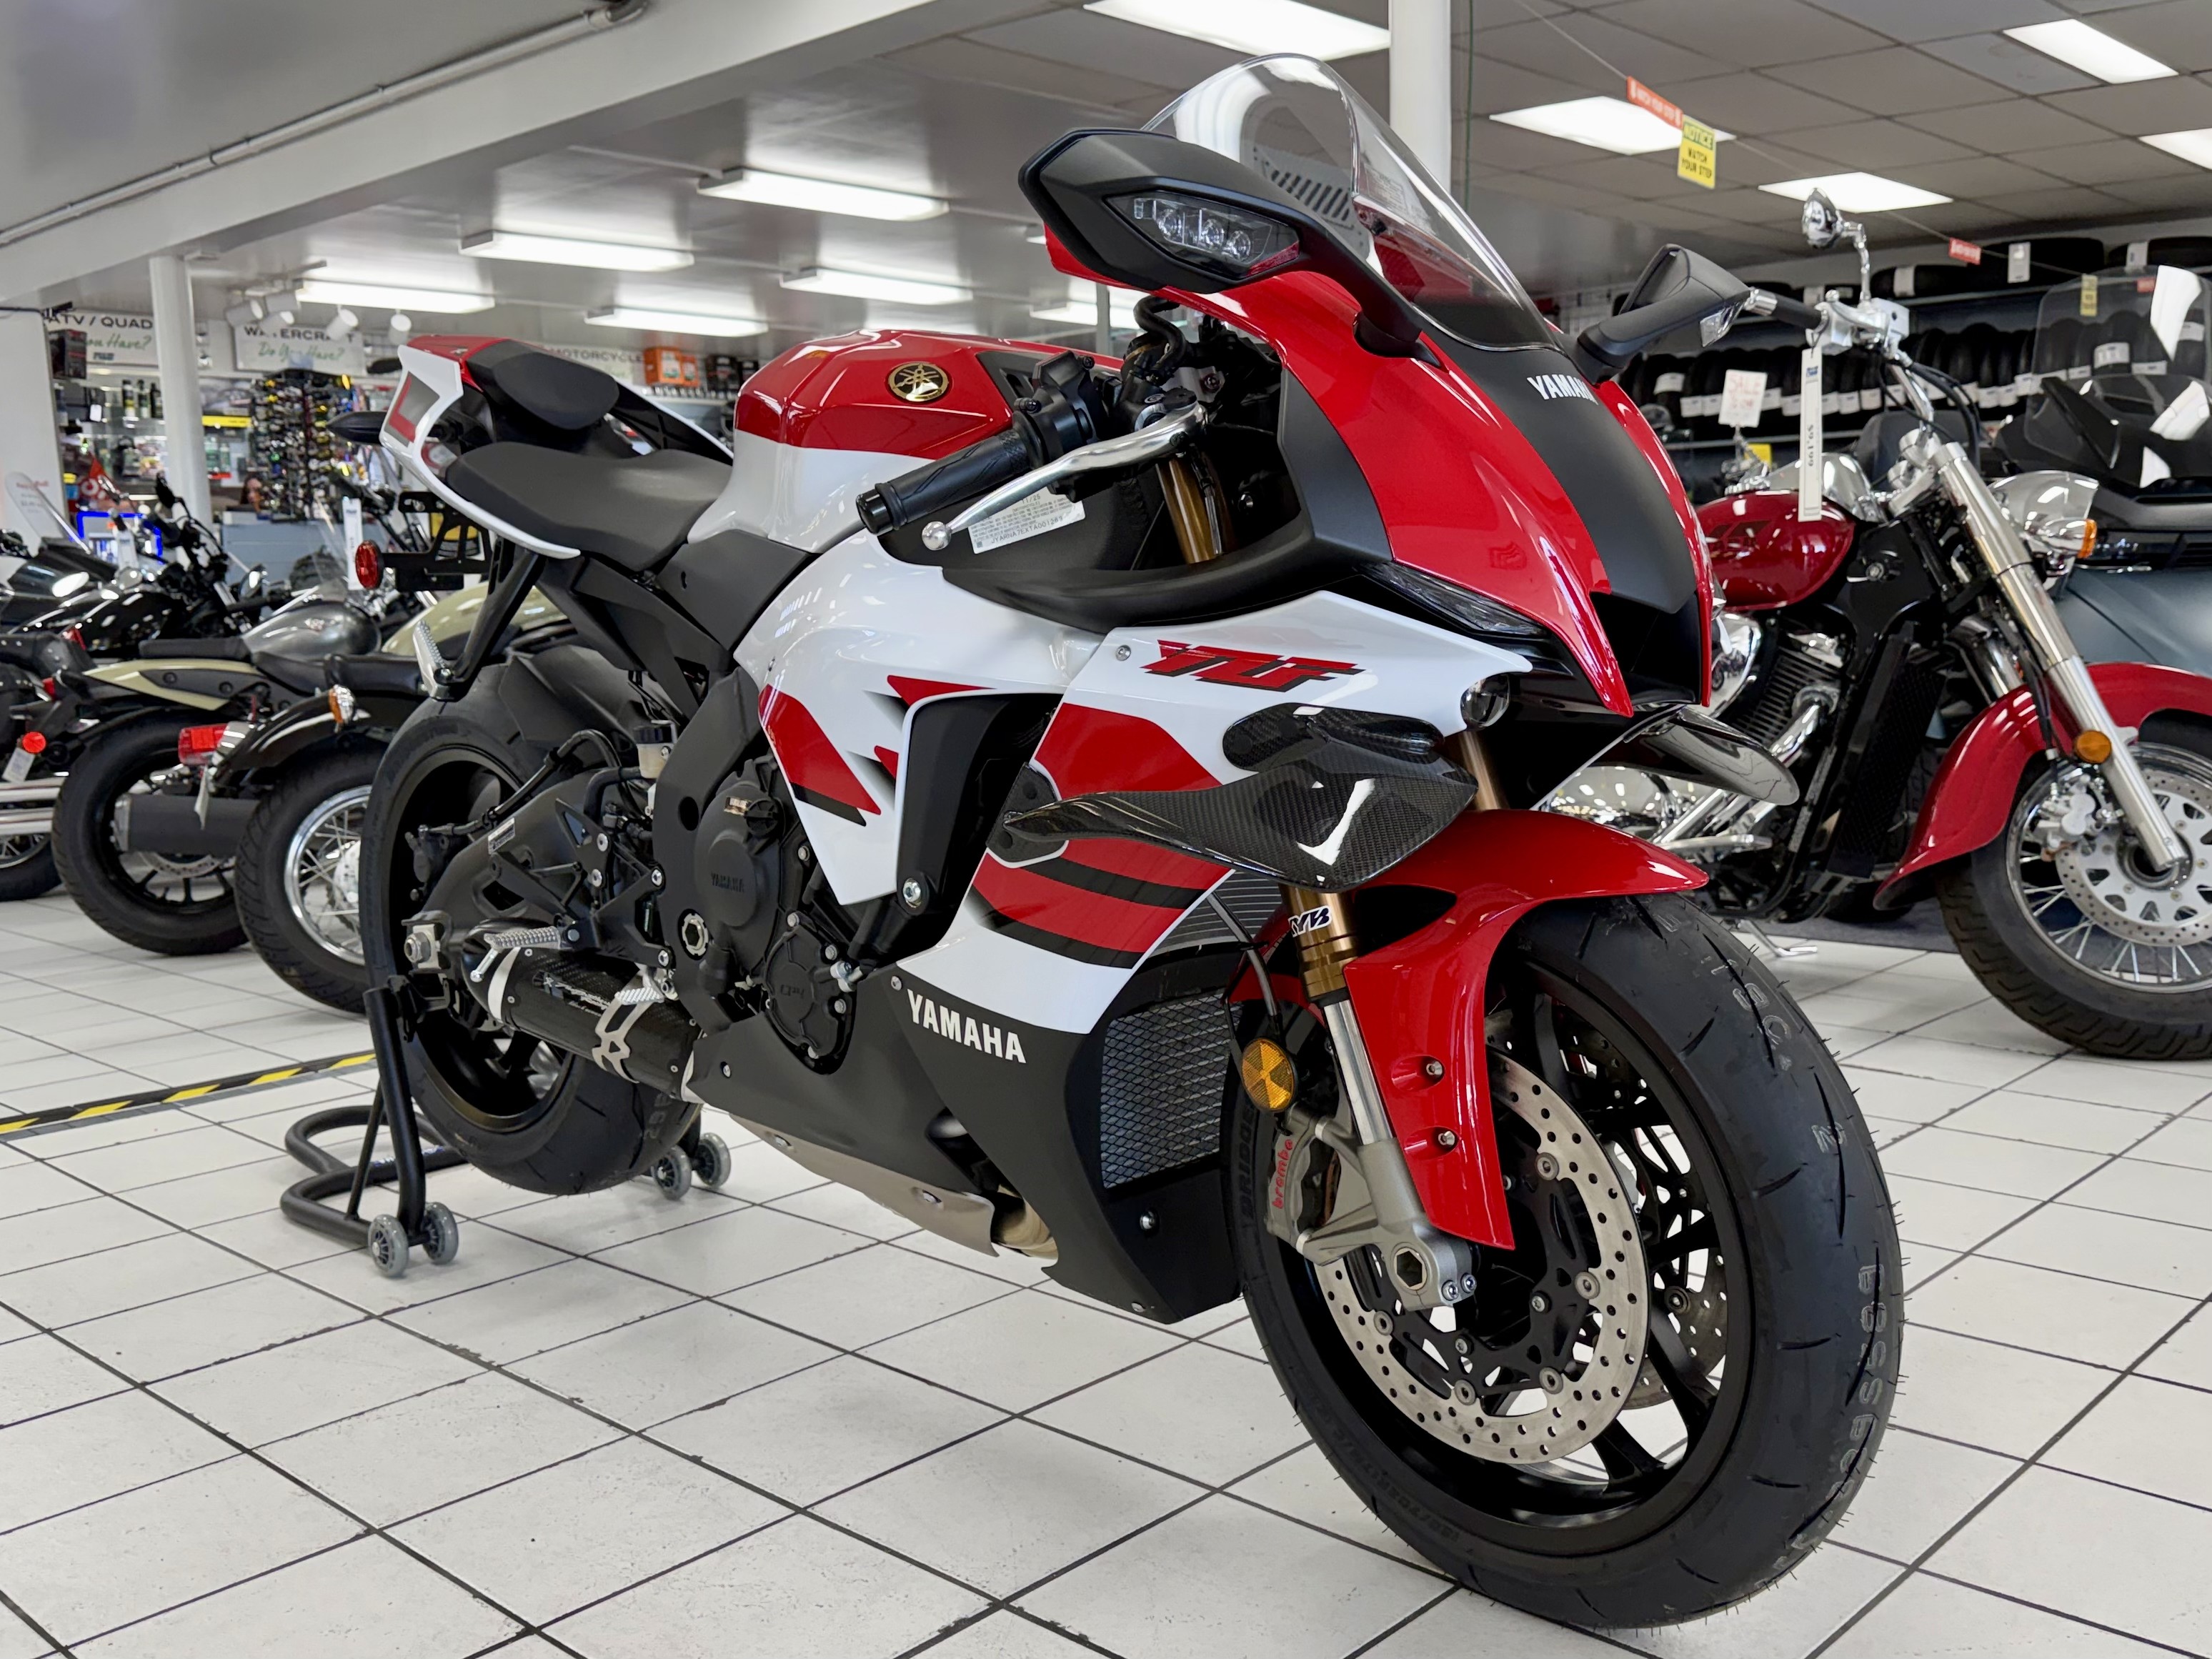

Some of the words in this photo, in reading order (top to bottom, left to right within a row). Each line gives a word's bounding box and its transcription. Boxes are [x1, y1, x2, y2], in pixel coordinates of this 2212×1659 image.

[1683, 121, 1713, 149] NOTICE
[1680, 157, 1698, 174] YOUR
[101, 317, 154, 329] QUAD
[106, 332, 152, 352] Have?
[907, 988, 1027, 1065] YAMAHA
[1272, 1139, 1293, 1210] brembo
